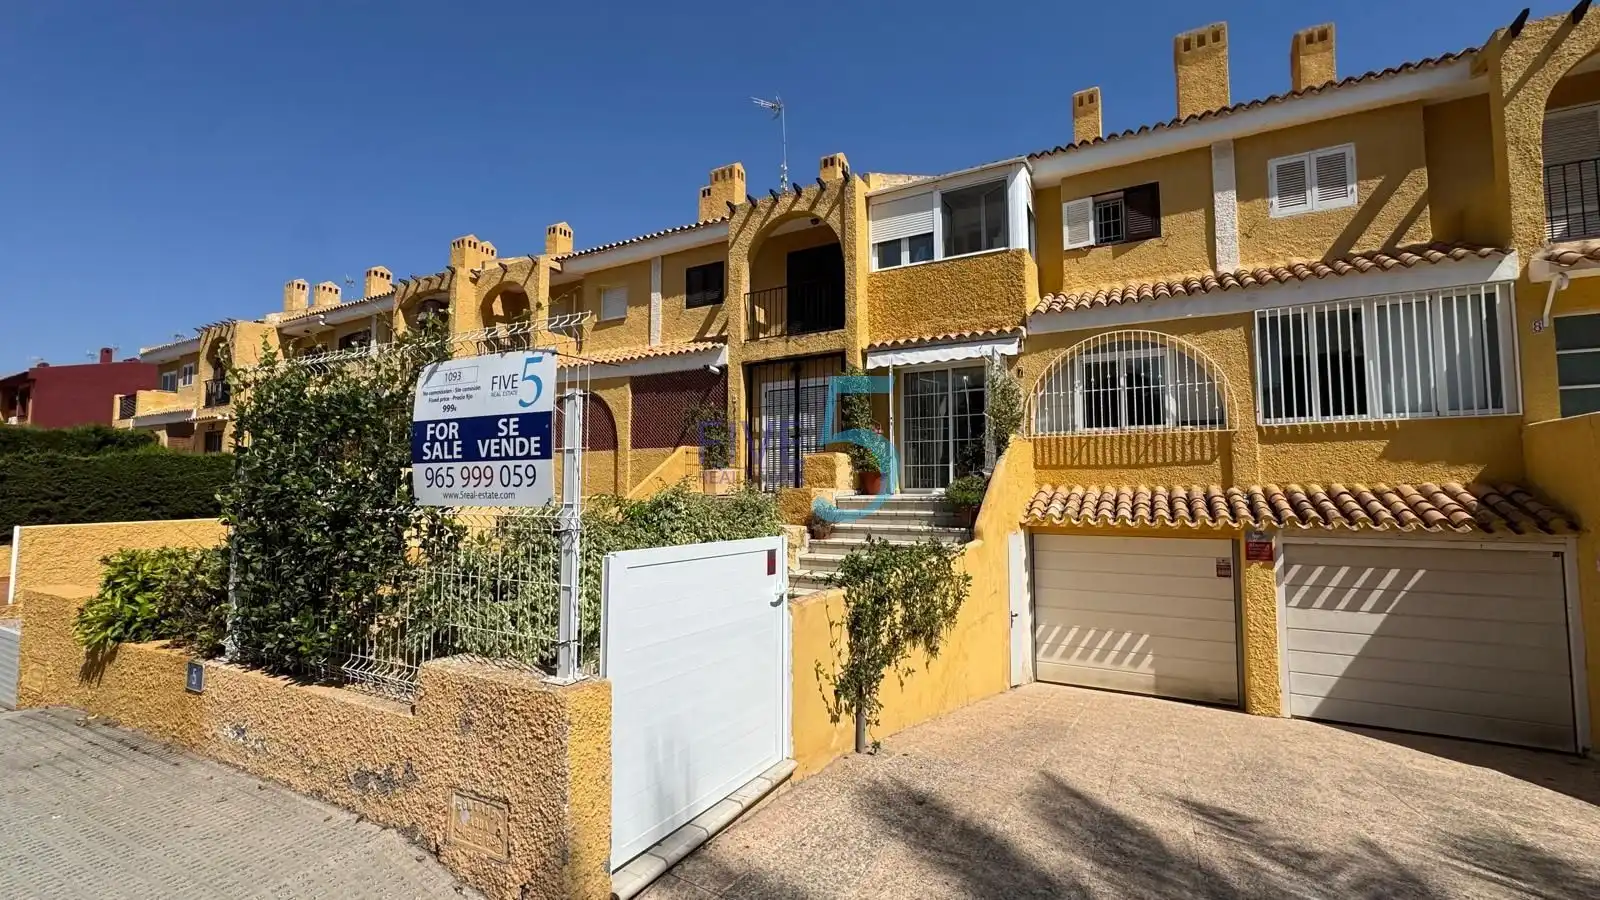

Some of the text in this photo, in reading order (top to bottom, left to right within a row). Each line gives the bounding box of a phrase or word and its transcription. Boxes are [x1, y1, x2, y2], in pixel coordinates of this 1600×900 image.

[444, 371, 462, 383] 1093
[491, 356, 544, 408] FIVE 5
[426, 422, 459, 440] FOR
[497, 417, 520, 437] SE
[422, 440, 463, 460] SALE
[477, 436, 541, 458] VENDE
[425, 464, 537, 489] 965 999 059
[442, 490, 516, 500] www.5real-estate.com
